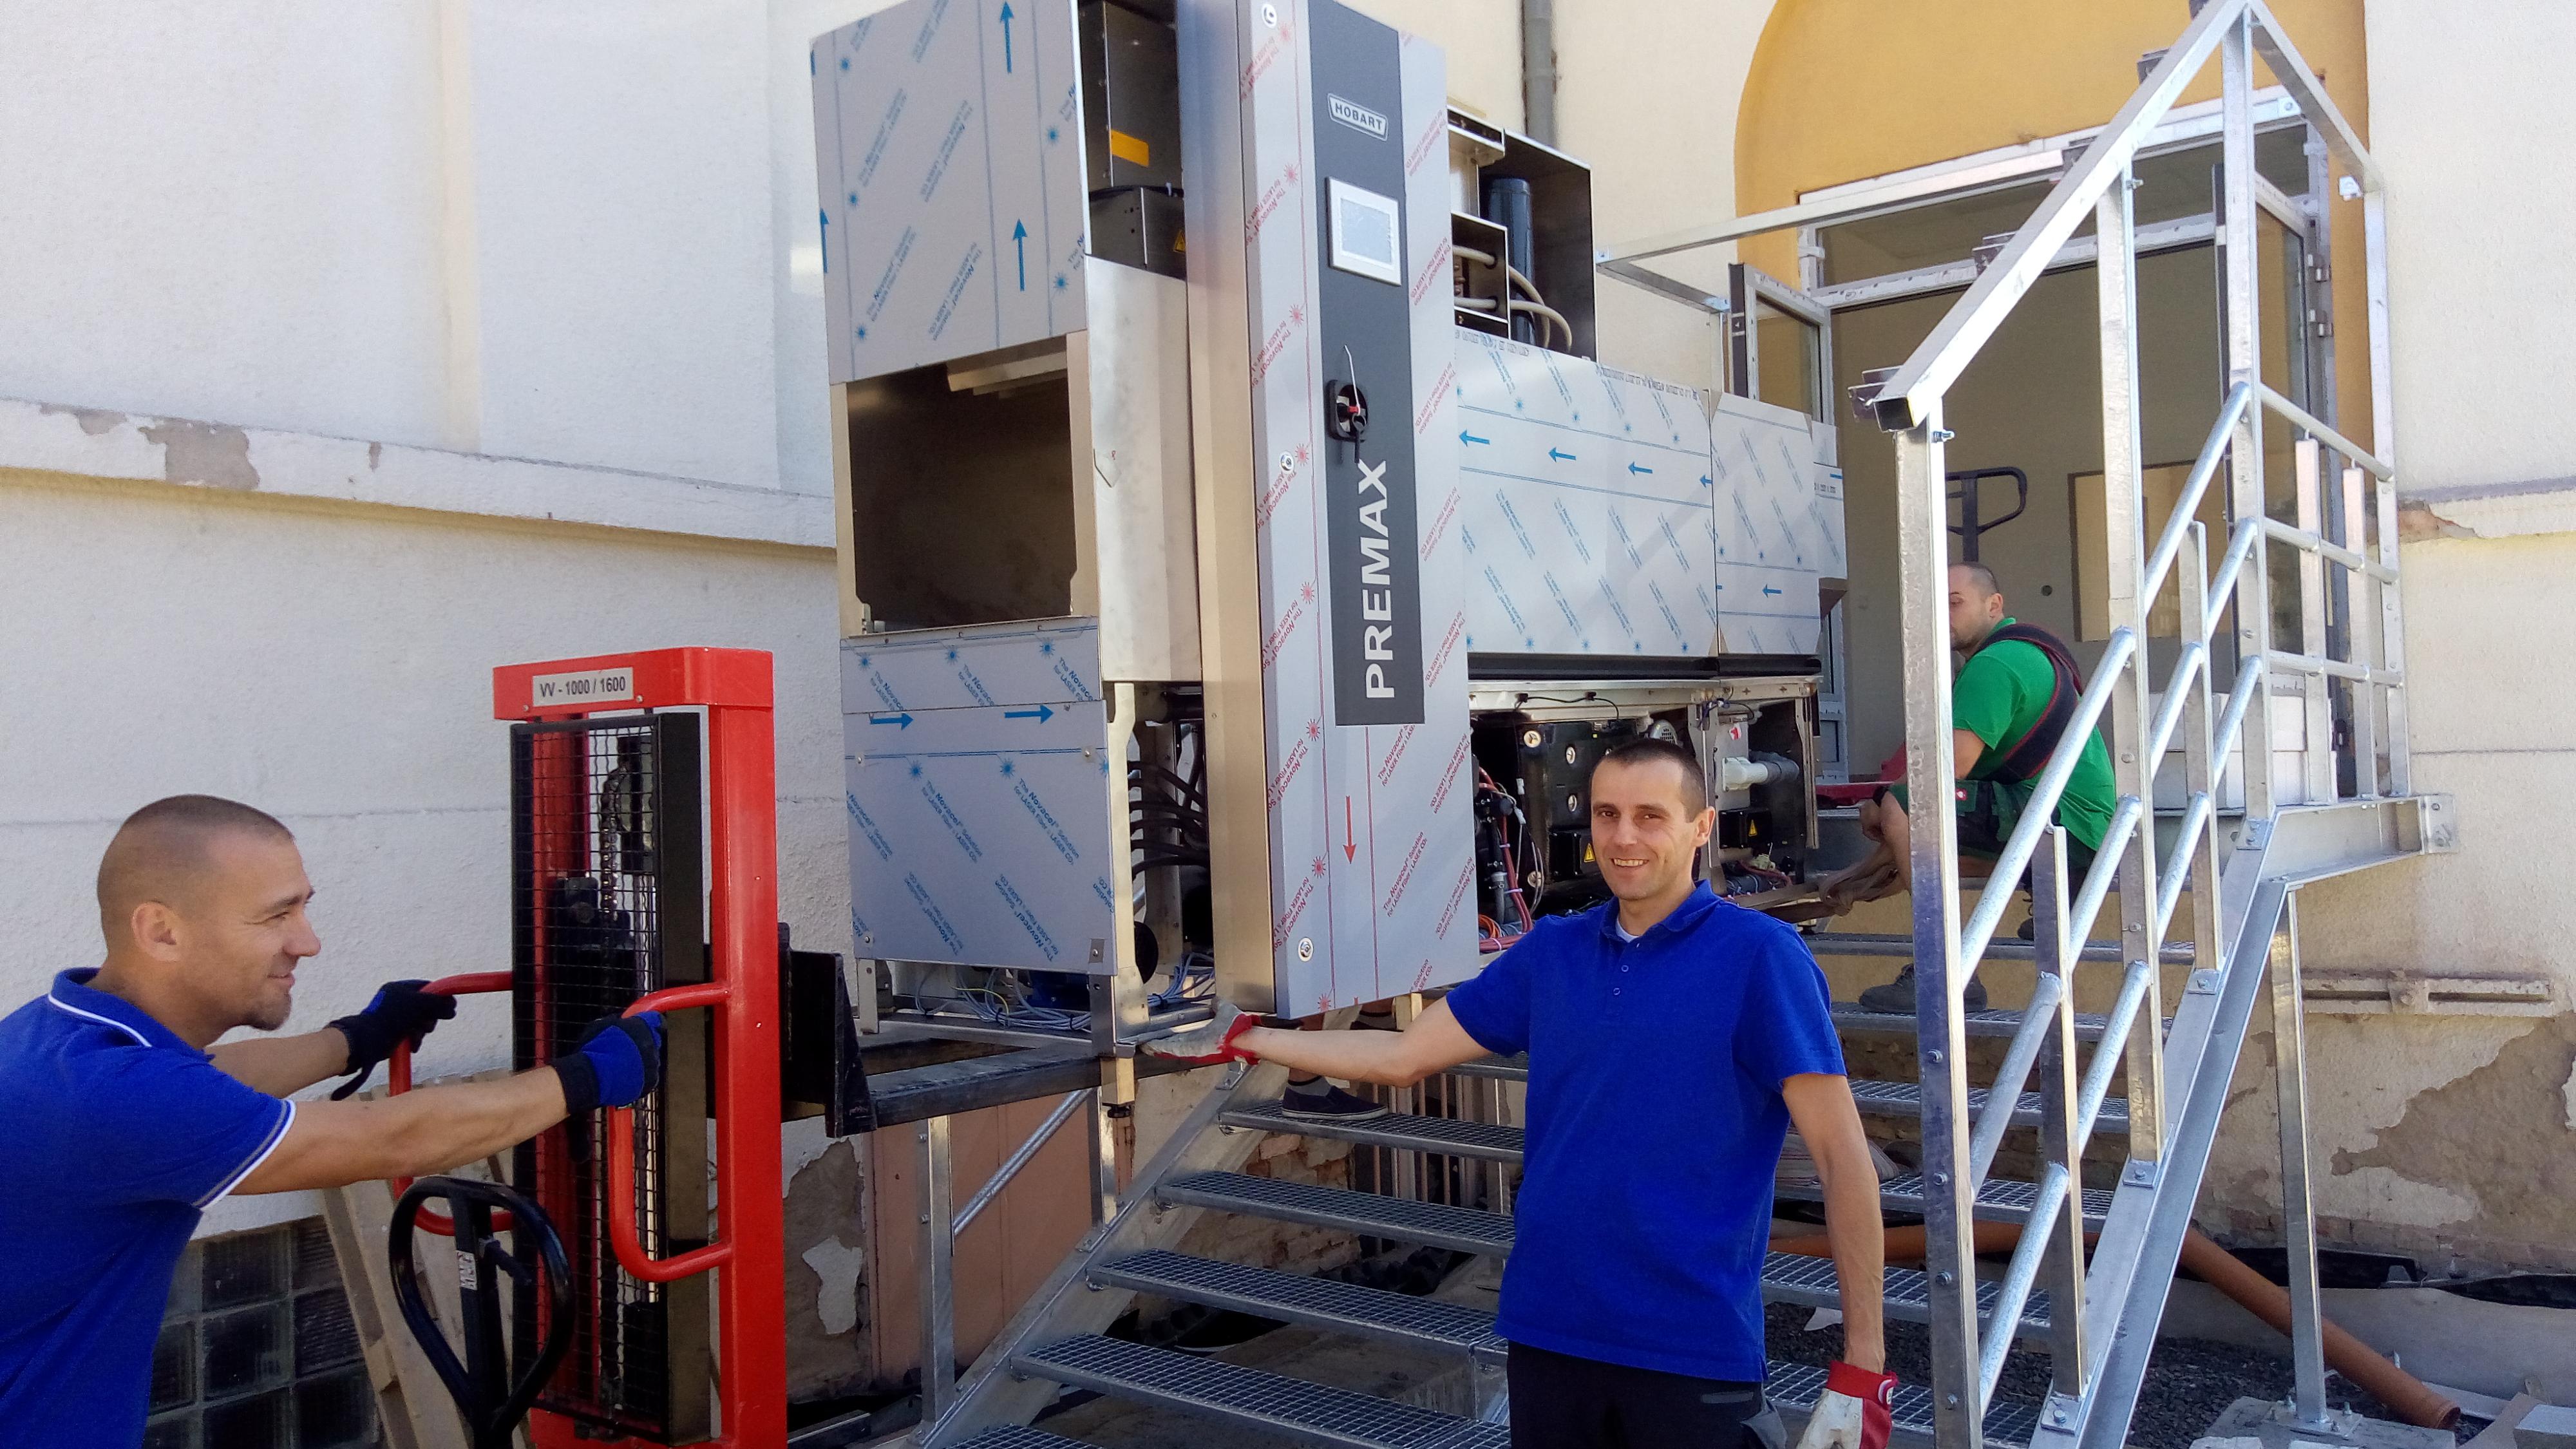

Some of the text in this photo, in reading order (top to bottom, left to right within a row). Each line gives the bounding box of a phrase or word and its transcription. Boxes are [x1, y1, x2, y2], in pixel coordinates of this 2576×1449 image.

[1335, 102, 1383, 130] HOBART
[1357, 459, 1395, 698] PREMAX
[540, 681, 556, 697] VV
[565, 679, 591, 696] 1000
[600, 676, 626, 693] 1600
[972, 677, 994, 706] Novace
[1069, 670, 1093, 701] Novace
